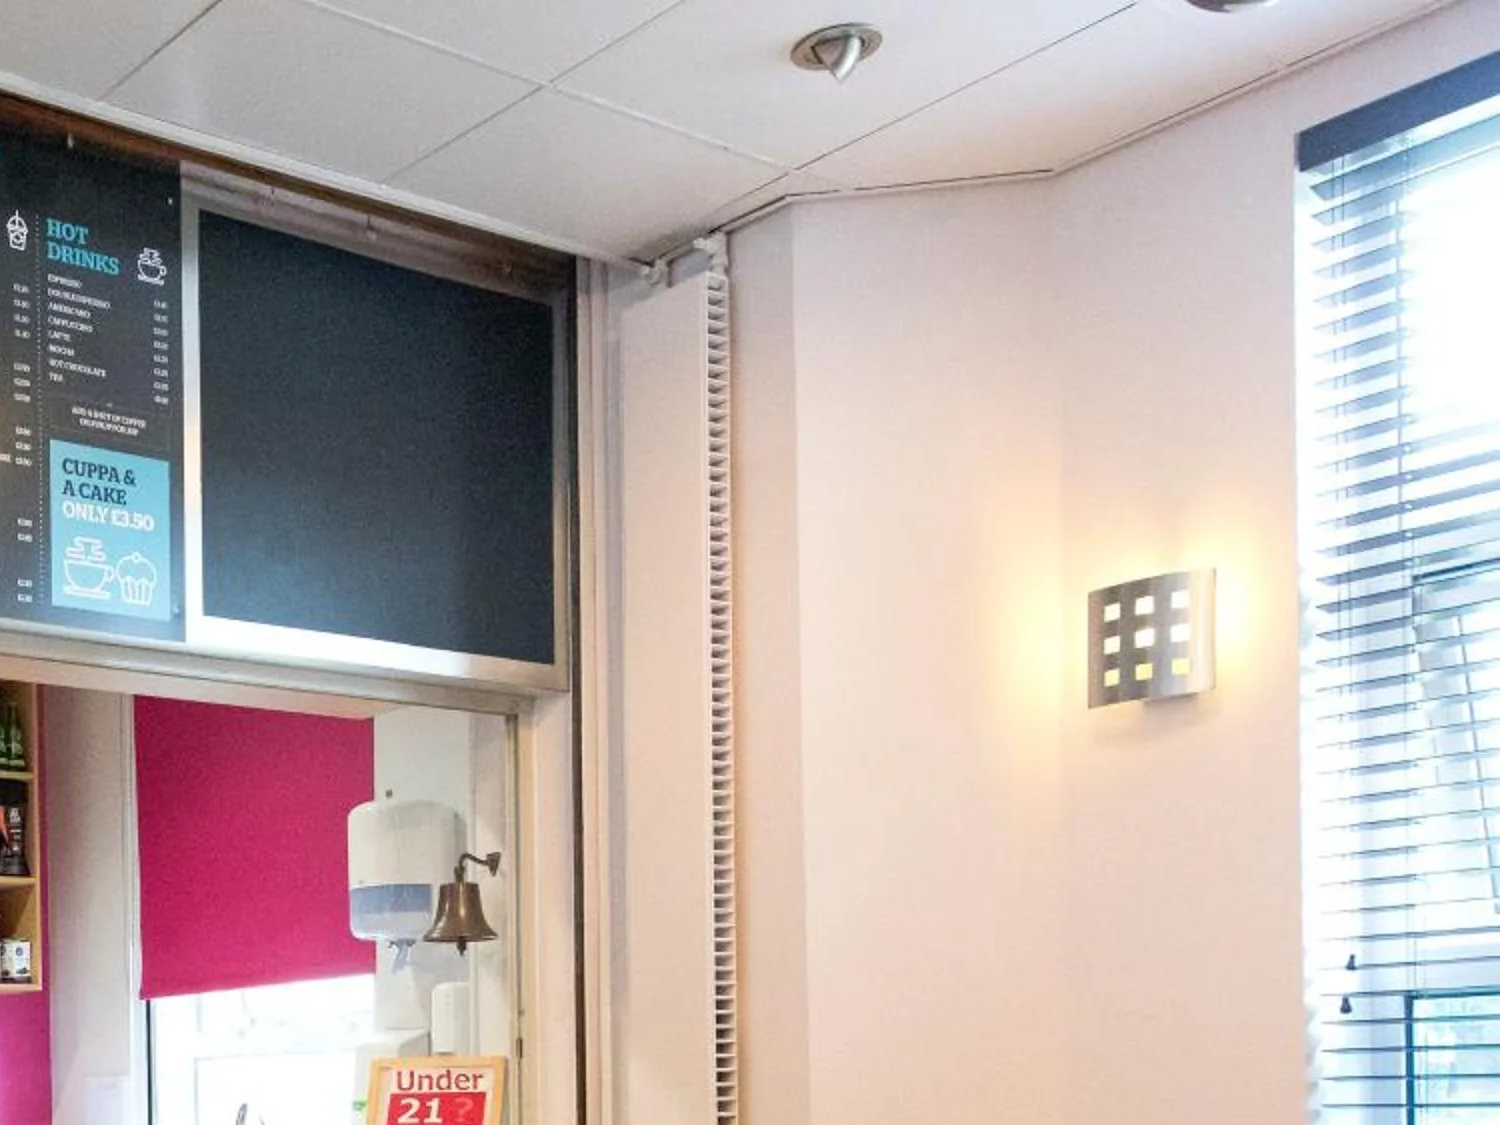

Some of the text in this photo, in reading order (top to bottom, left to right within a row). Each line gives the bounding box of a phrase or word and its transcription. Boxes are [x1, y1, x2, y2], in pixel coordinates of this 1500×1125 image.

[46, 218, 89, 245] HOT
[47, 242, 120, 276] DRINKS
[61, 457, 137, 487] CUPPA &
[61, 479, 76, 497] A
[63, 500, 155, 532] ONLY £3.50
[397, 1070, 484, 1091] Under
